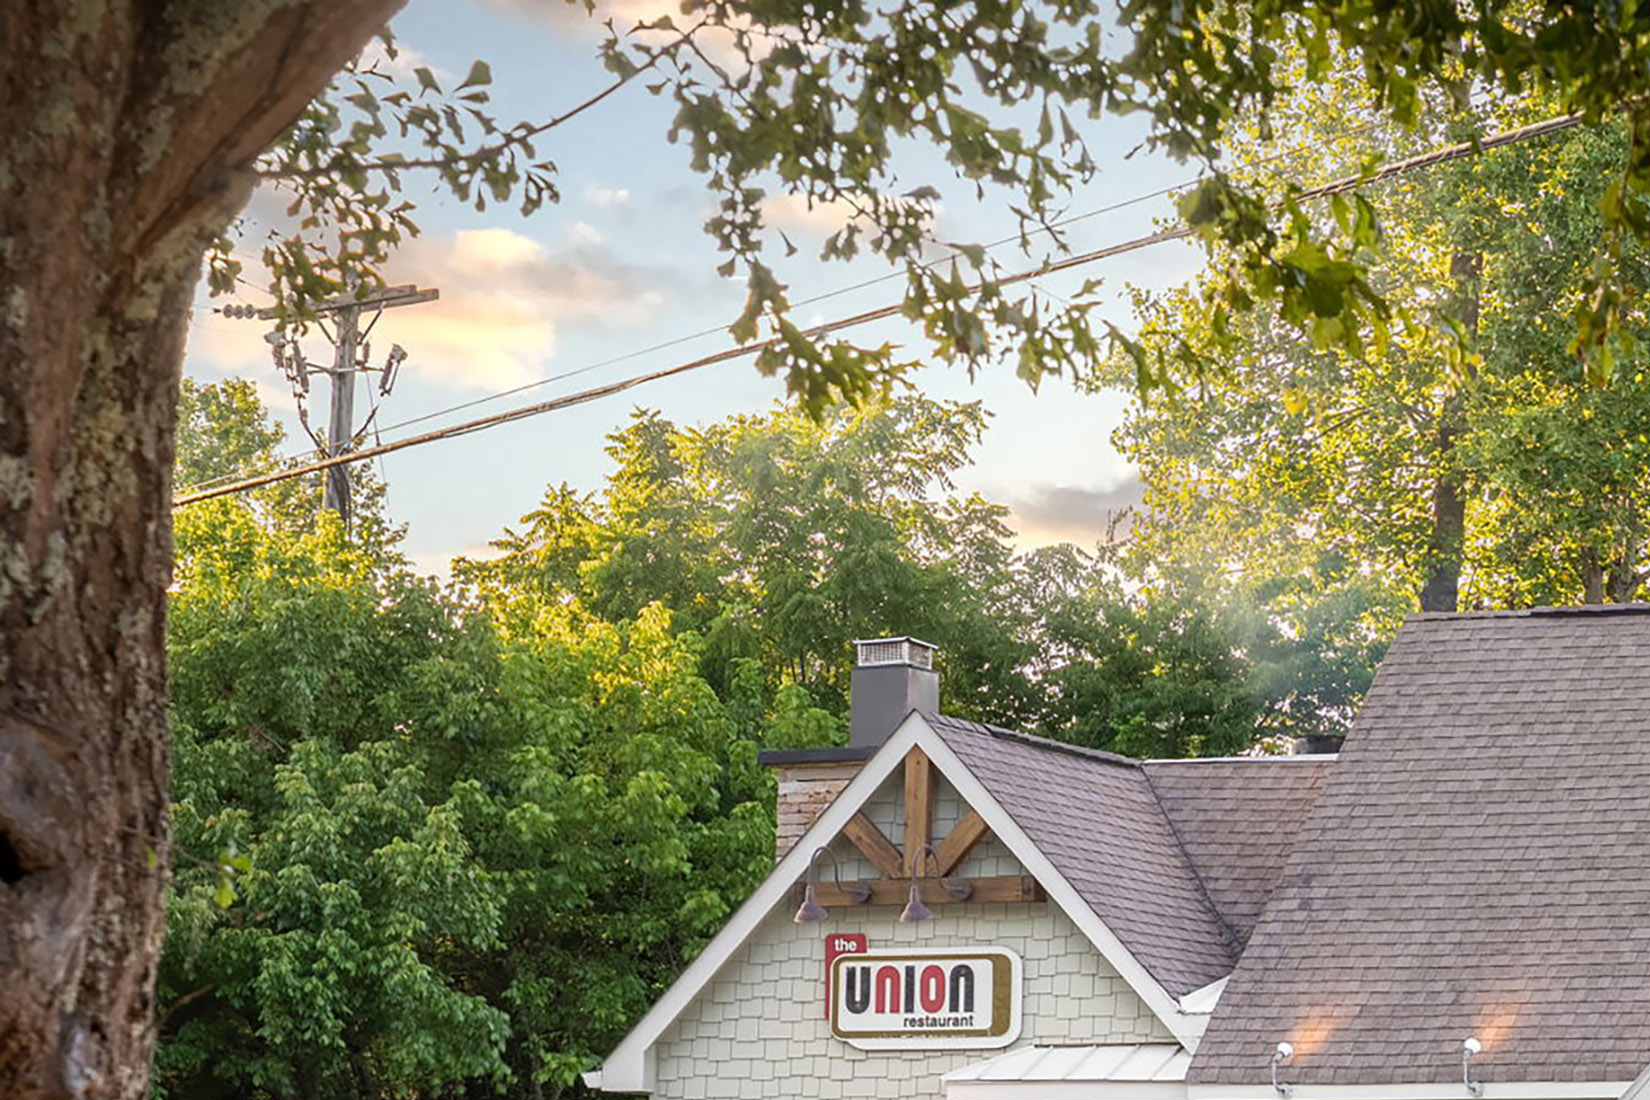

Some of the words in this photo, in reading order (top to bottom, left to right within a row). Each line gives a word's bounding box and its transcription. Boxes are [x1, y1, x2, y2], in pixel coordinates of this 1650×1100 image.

[834, 938, 857, 952] the
[845, 964, 974, 1014] UNION
[903, 1015, 974, 1027] restaurant
